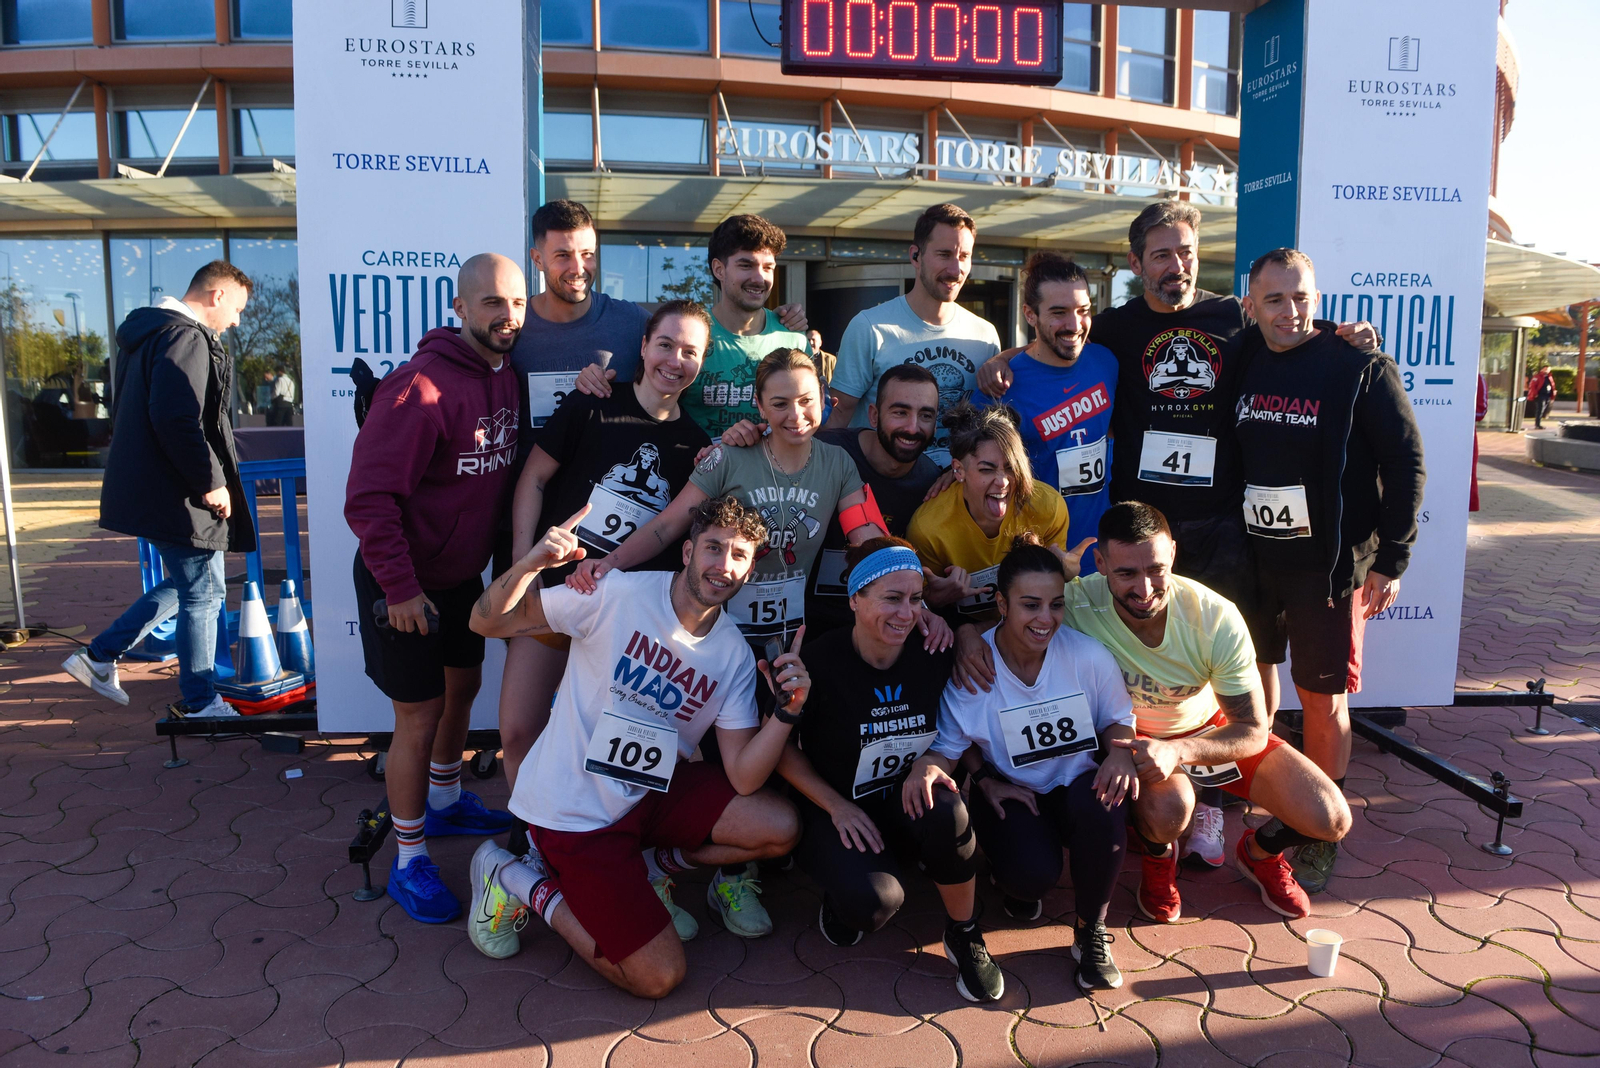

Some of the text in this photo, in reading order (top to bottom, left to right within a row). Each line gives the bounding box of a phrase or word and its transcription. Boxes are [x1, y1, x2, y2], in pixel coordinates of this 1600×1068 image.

[803, 0, 1043, 66] 00:00:00
[345, 38, 475, 57] EUROSTARS
[361, 58, 458, 70] TORRE SEVILLA
[1247, 61, 1297, 93] EUROSTARS
[1348, 80, 1456, 96] EUROSTARS
[1252, 79, 1290, 100] TORRE SEVILLA
[1361, 98, 1442, 109] TORRE SEVILLA
[333, 153, 491, 174] TORRE SEVILLA
[718, 127, 1175, 187] EUROSTARS TORRE SEVILLA
[1243, 171, 1293, 194] TORRE SEVILLA
[1332, 185, 1462, 202] TORRE SEVILLA
[362, 250, 462, 268] CARRERA
[1351, 272, 1433, 288] CARRERA
[1146, 330, 1218, 356] HYROX SEVILLA
[1041, 389, 1107, 436] JUST DO IT.
[1253, 394, 1320, 415] INDIAN
[1413, 398, 1453, 406] SEVILLA
[1250, 409, 1283, 423] NATIVE
[1285, 413, 1317, 426] TEAM
[1079, 458, 1104, 484] 50
[1162, 450, 1191, 474] 41
[748, 487, 819, 508] INDIANS
[1252, 504, 1294, 527] 104
[602, 514, 637, 543] 92
[769, 531, 795, 549] OF
[748, 598, 787, 623] 151
[624, 630, 718, 703] INDIAN
[613, 655, 704, 722] MADE
[860, 714, 926, 735] FINISHER
[1021, 717, 1077, 750] 188
[607, 737, 662, 771] 109
[872, 752, 917, 778] 198
